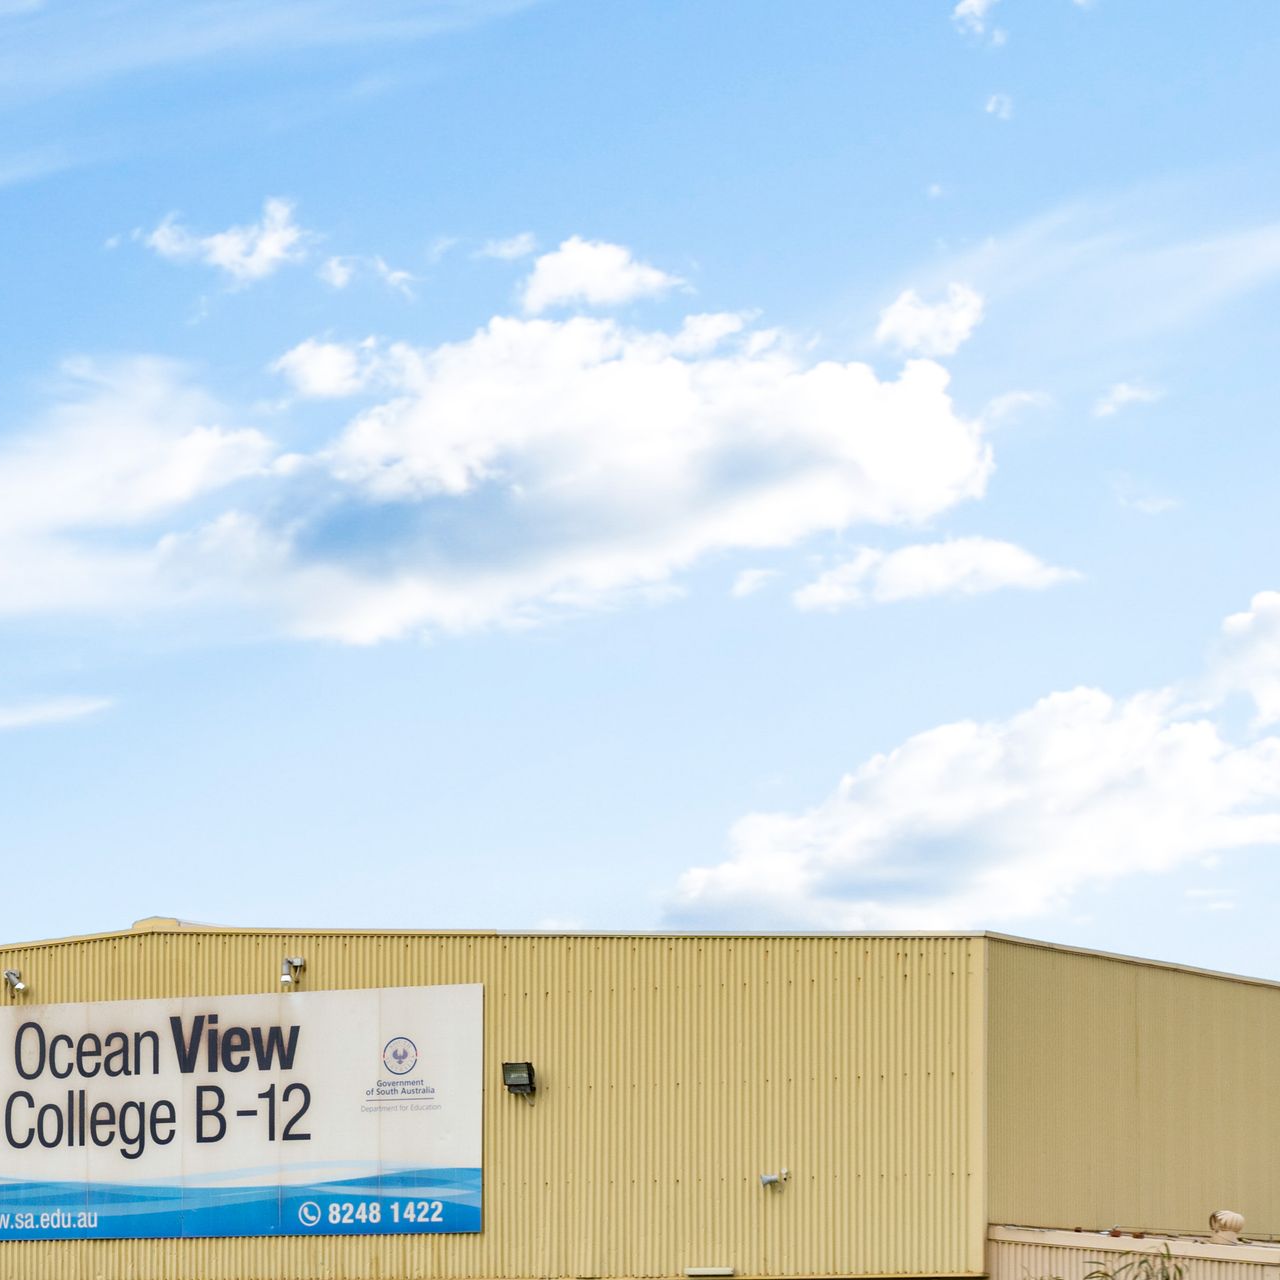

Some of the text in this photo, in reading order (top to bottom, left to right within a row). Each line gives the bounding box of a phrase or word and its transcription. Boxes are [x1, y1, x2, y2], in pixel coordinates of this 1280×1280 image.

[14, 1014, 301, 1080] Ocean View
[365, 1086, 435, 1096] of South Australia
[376, 1079, 424, 1088] Government
[360, 1103, 442, 1113] Department for Education
[4, 1090, 177, 1160] College
[328, 1201, 444, 1224] 8248 1422
